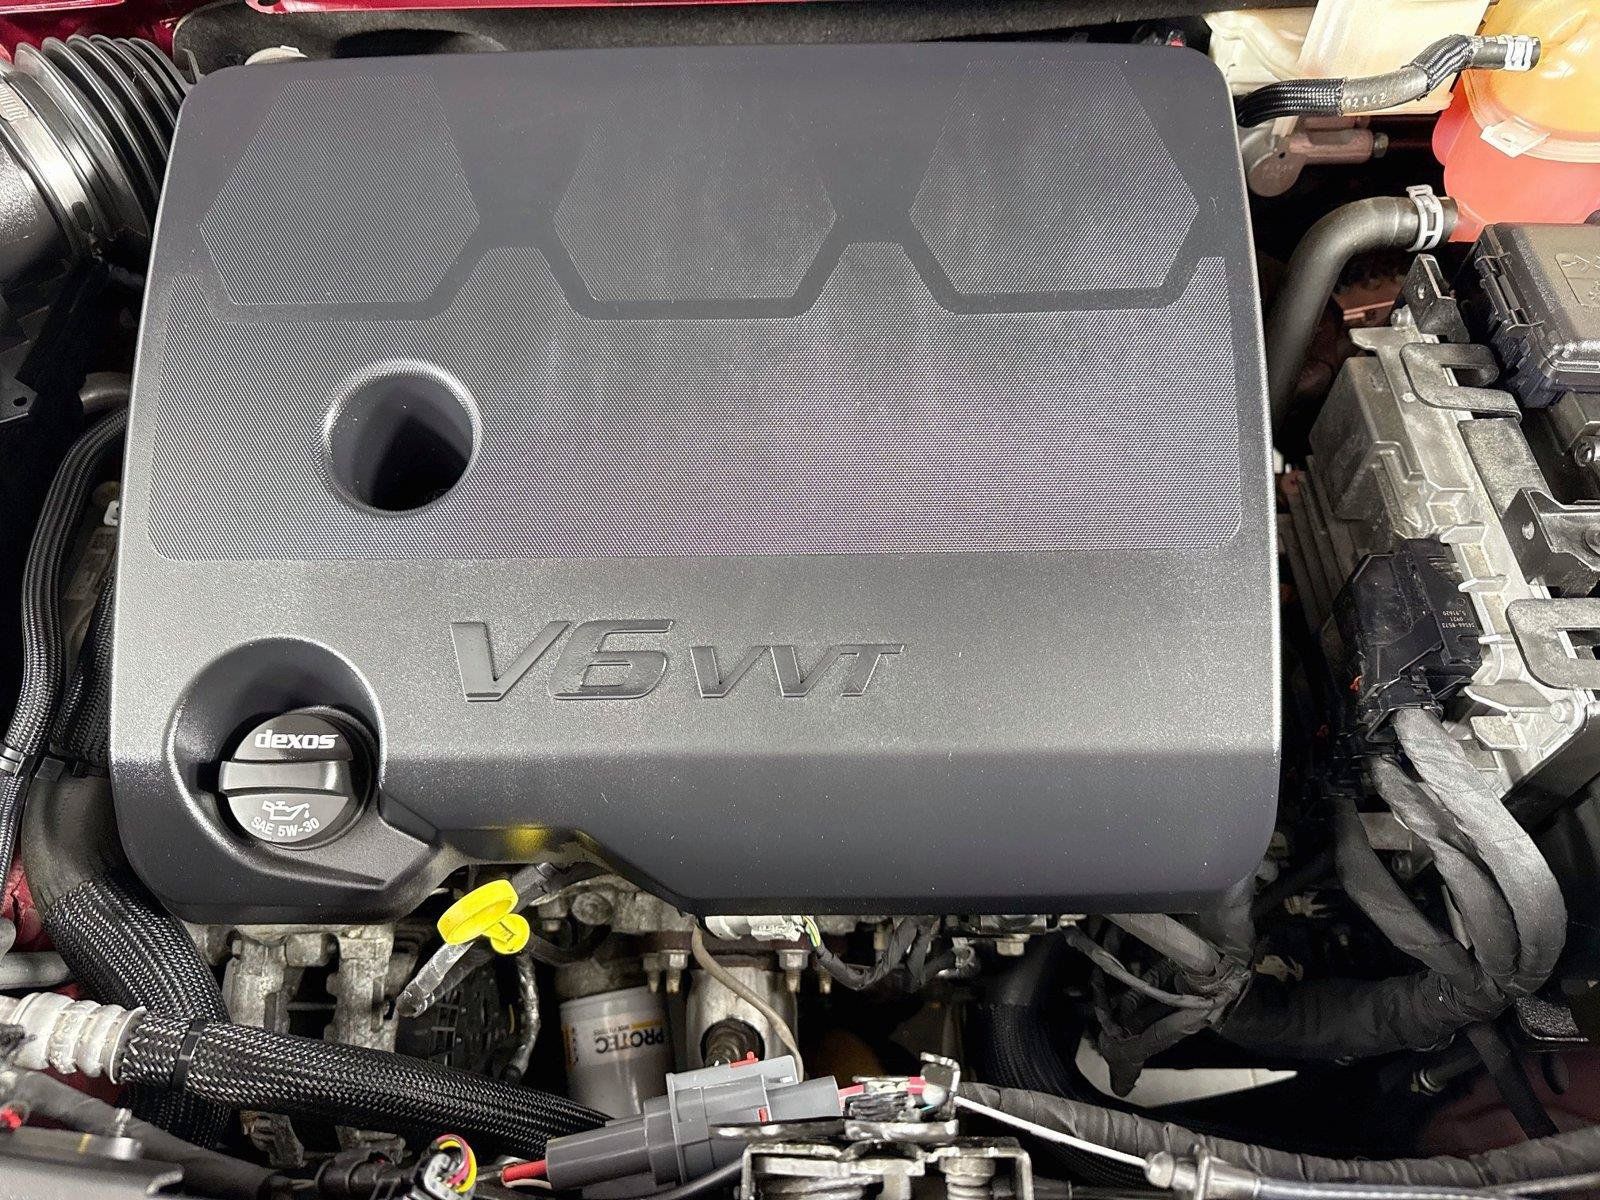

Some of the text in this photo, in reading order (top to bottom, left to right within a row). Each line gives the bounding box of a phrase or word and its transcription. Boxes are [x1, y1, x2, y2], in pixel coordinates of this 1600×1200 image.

[449, 618, 906, 702] V6 VVT
[255, 729, 339, 750] dexos
[251, 816, 320, 837] SAE 5W-30
[594, 1027, 664, 1055] PROTEC
